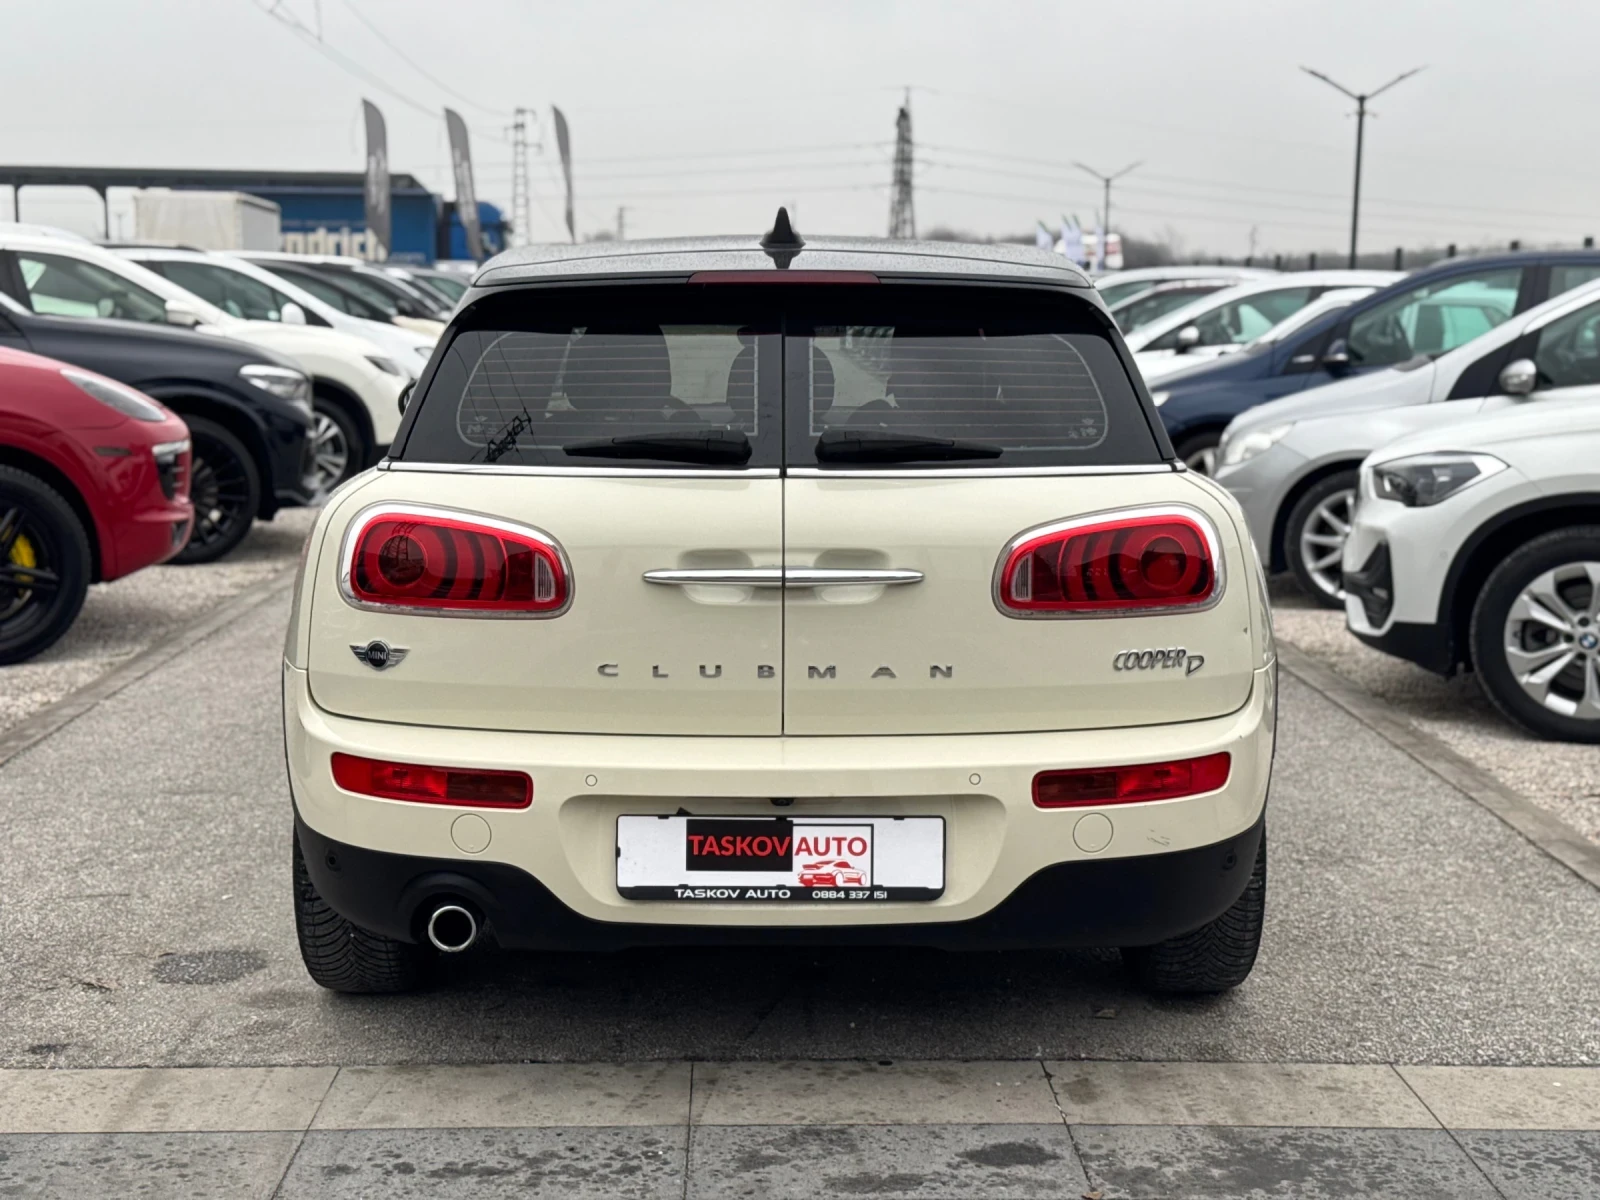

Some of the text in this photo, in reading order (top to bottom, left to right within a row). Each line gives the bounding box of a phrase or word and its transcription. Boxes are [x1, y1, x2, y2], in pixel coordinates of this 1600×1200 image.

[368, 650, 387, 660] MINI
[1112, 648, 1205, 677] COOPER D
[597, 663, 953, 679] CLUBMAN
[688, 835, 868, 856] TASKOV AUTO
[674, 888, 741, 899] TASKOV
[744, 888, 791, 899] AUTO
[812, 890, 846, 899] 0884
[848, 890, 870, 899] 337
